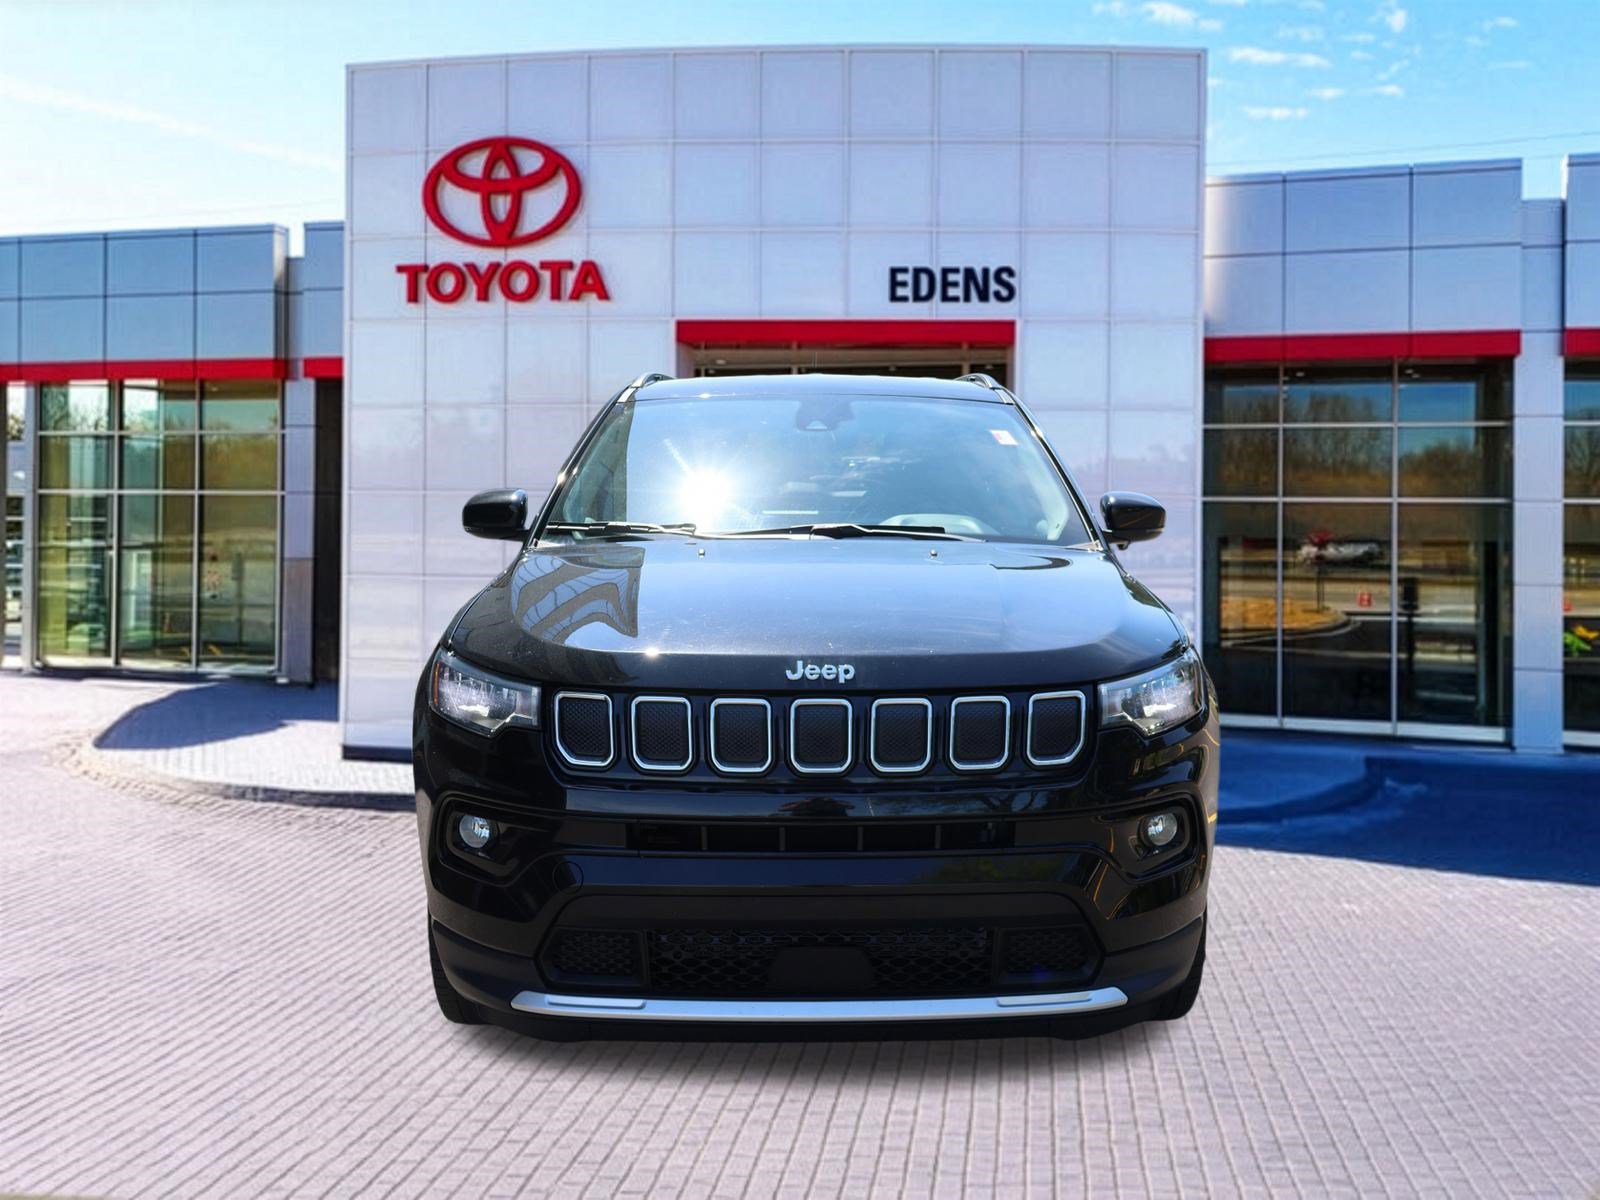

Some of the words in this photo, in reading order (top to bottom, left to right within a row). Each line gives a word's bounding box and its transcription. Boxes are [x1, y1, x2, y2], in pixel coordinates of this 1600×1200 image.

[396, 260, 611, 304] TOYOTA
[889, 266, 1016, 303] EDENS
[785, 660, 855, 684] Jeep
